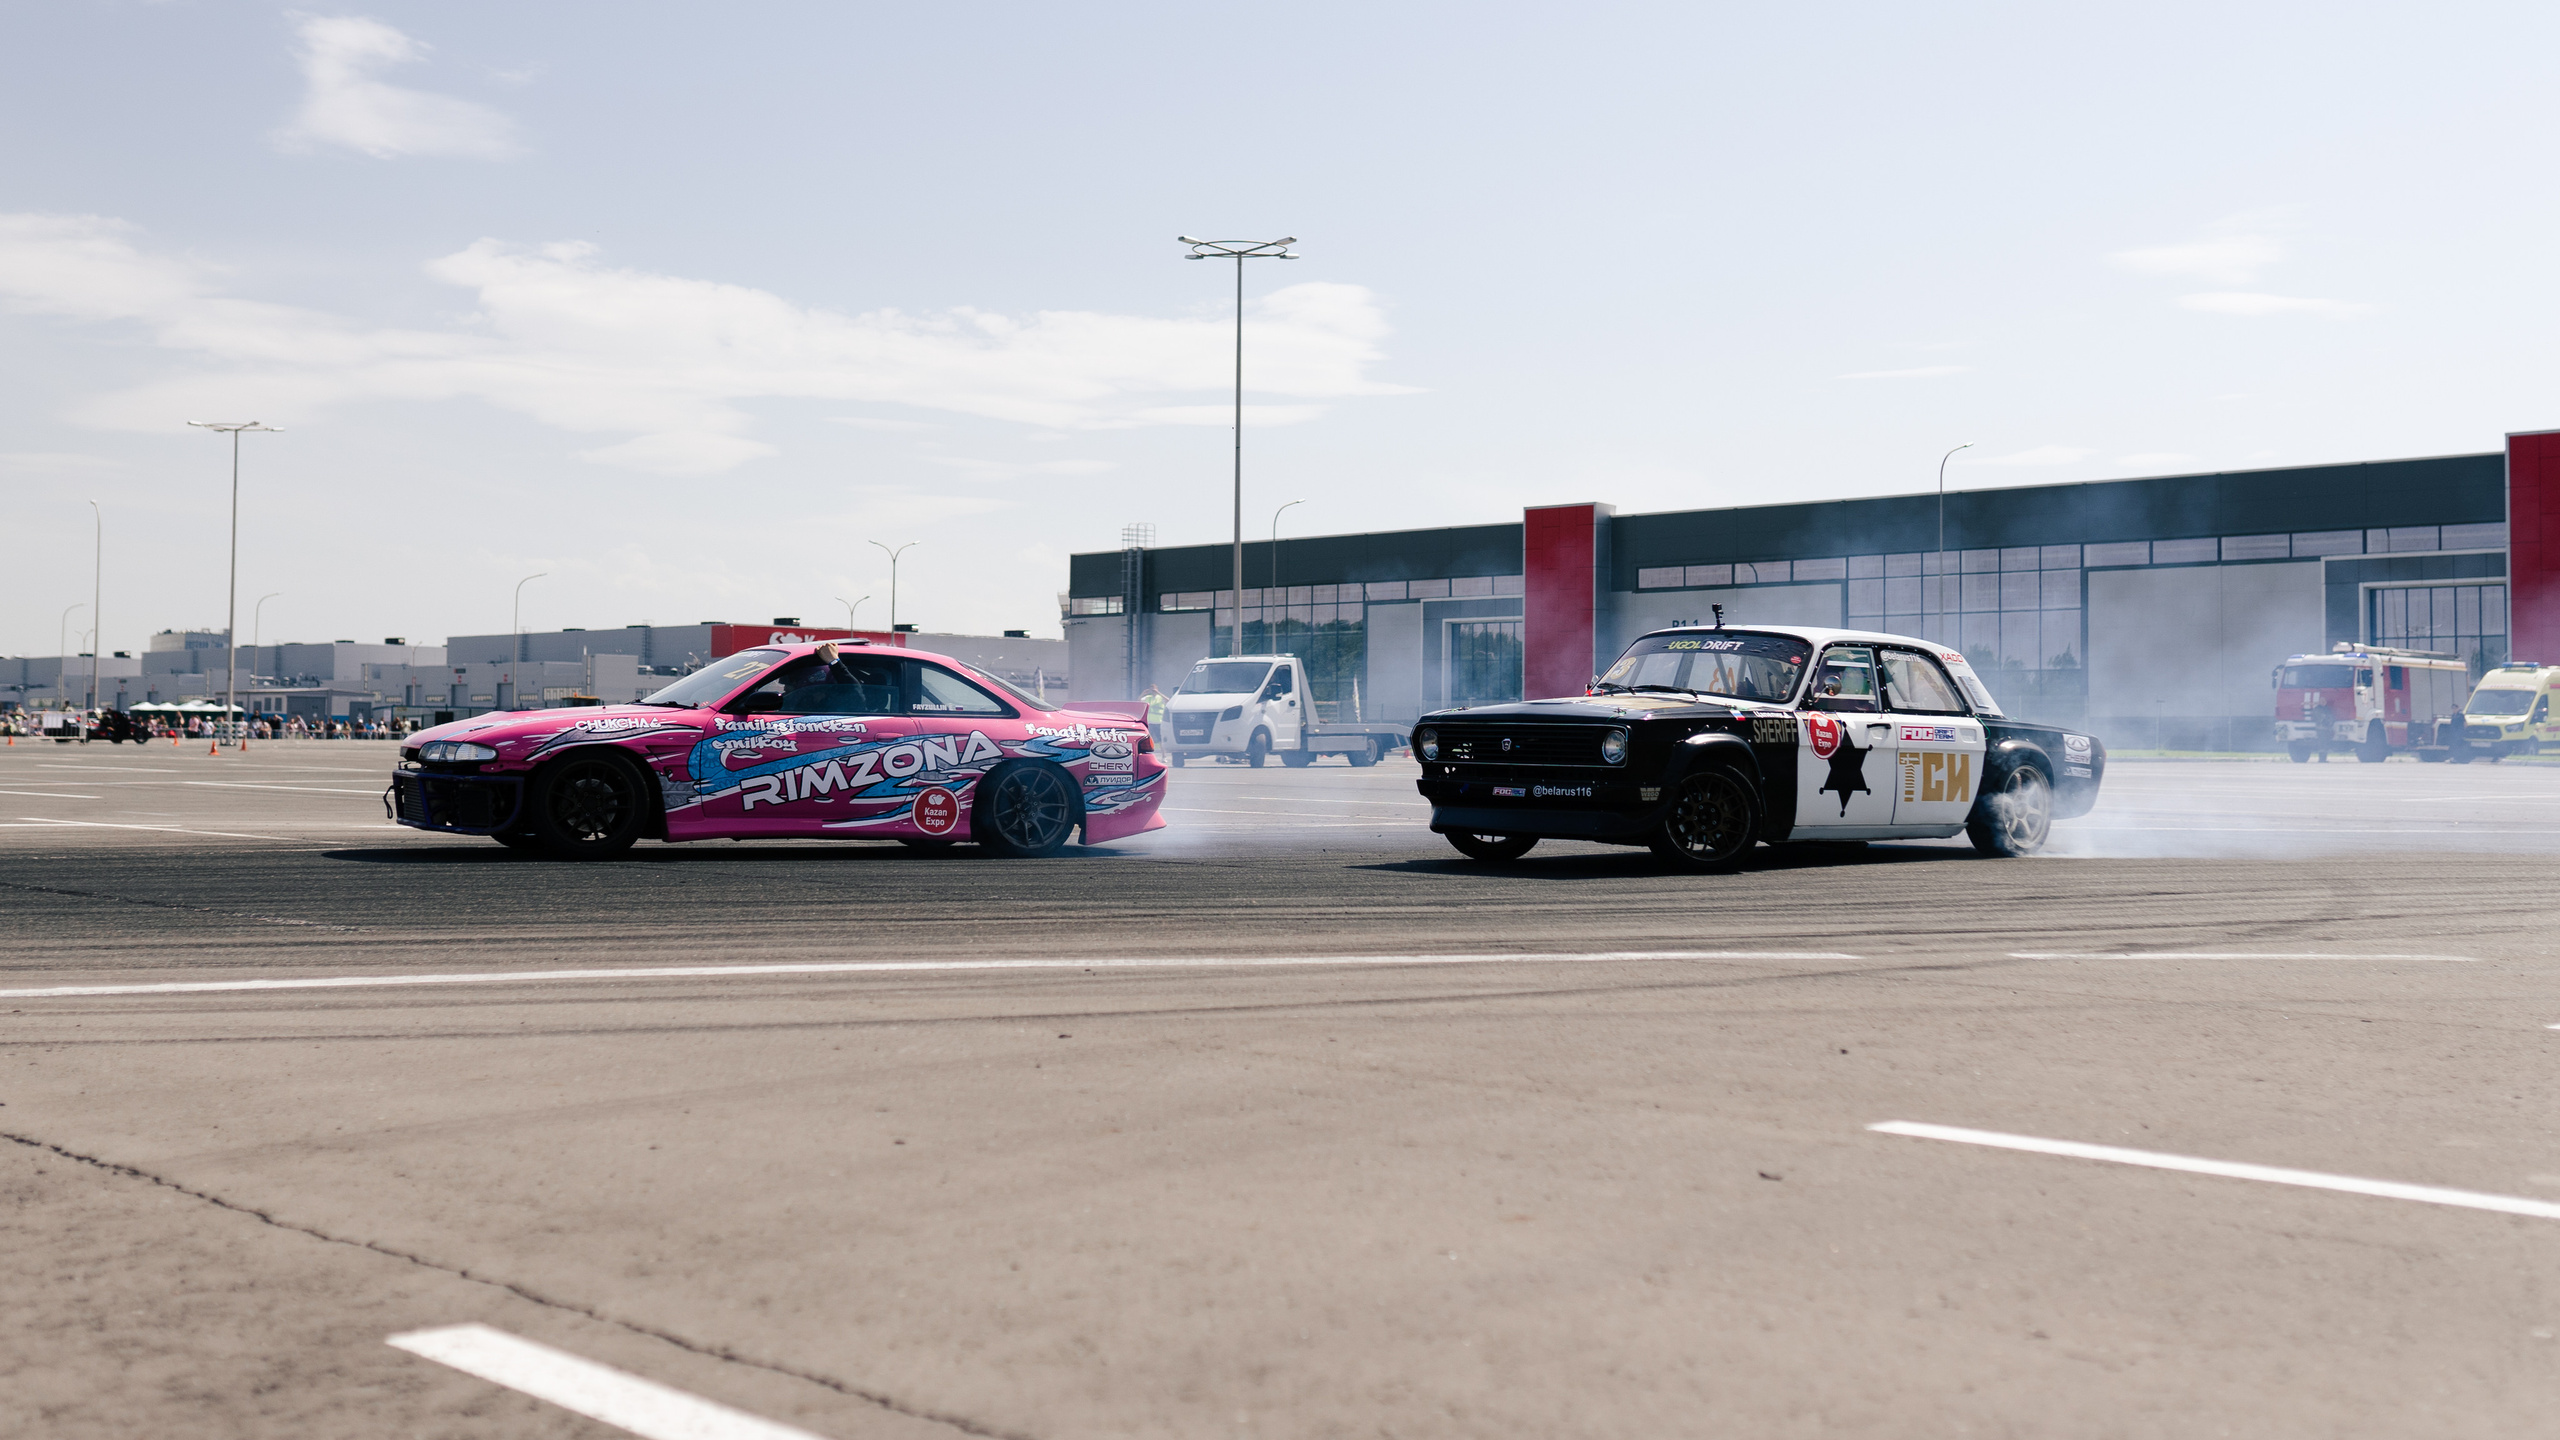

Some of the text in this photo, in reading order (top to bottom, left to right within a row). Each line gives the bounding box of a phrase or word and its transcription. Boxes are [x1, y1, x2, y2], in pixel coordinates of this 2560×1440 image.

[1939, 652, 1964, 663] XADO
[723, 661, 771, 680] 27
[1192, 665, 1207, 673] 53
[1610, 656, 1637, 680] 3
[1753, 719, 1798, 743] SHERIFF
[1815, 728, 1833, 739] Kazan
[1817, 738, 1832, 750] Expo
[740, 730, 1004, 811] RIMZONA
[1089, 762, 1132, 771] CHERY
[1100, 776, 1132, 784] ЛУИДОР
[1532, 785, 1592, 798] @belarus116
[924, 807, 948, 817] Kazan
[925, 817, 945, 827] Expo
